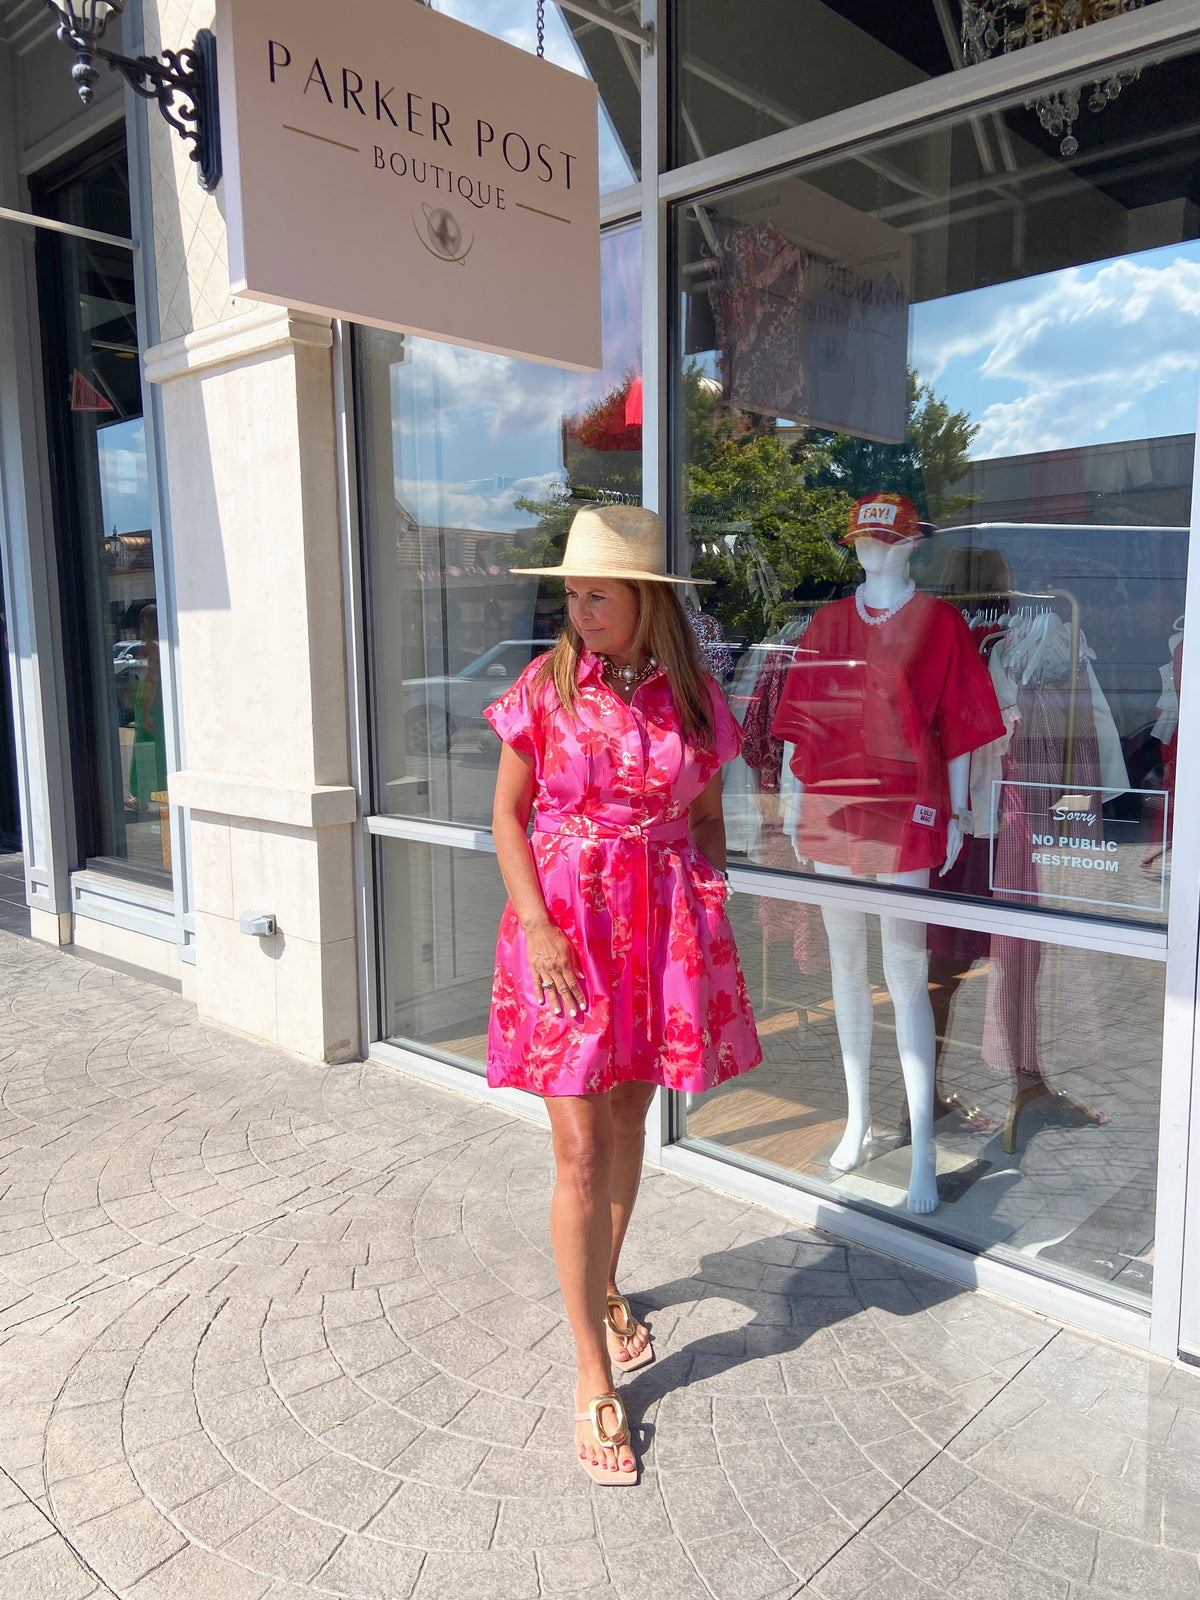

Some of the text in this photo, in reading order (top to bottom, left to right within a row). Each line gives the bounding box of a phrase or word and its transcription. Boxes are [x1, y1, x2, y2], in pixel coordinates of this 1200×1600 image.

[268, 39, 577, 190] PARKER POST
[373, 145, 506, 210] BOUTIQUE
[863, 508, 890, 519] FAY!
[1053, 806, 1096, 826] Sorry
[1032, 834, 1118, 852] NO PUBLIC
[1031, 853, 1119, 871] RESTROOM
